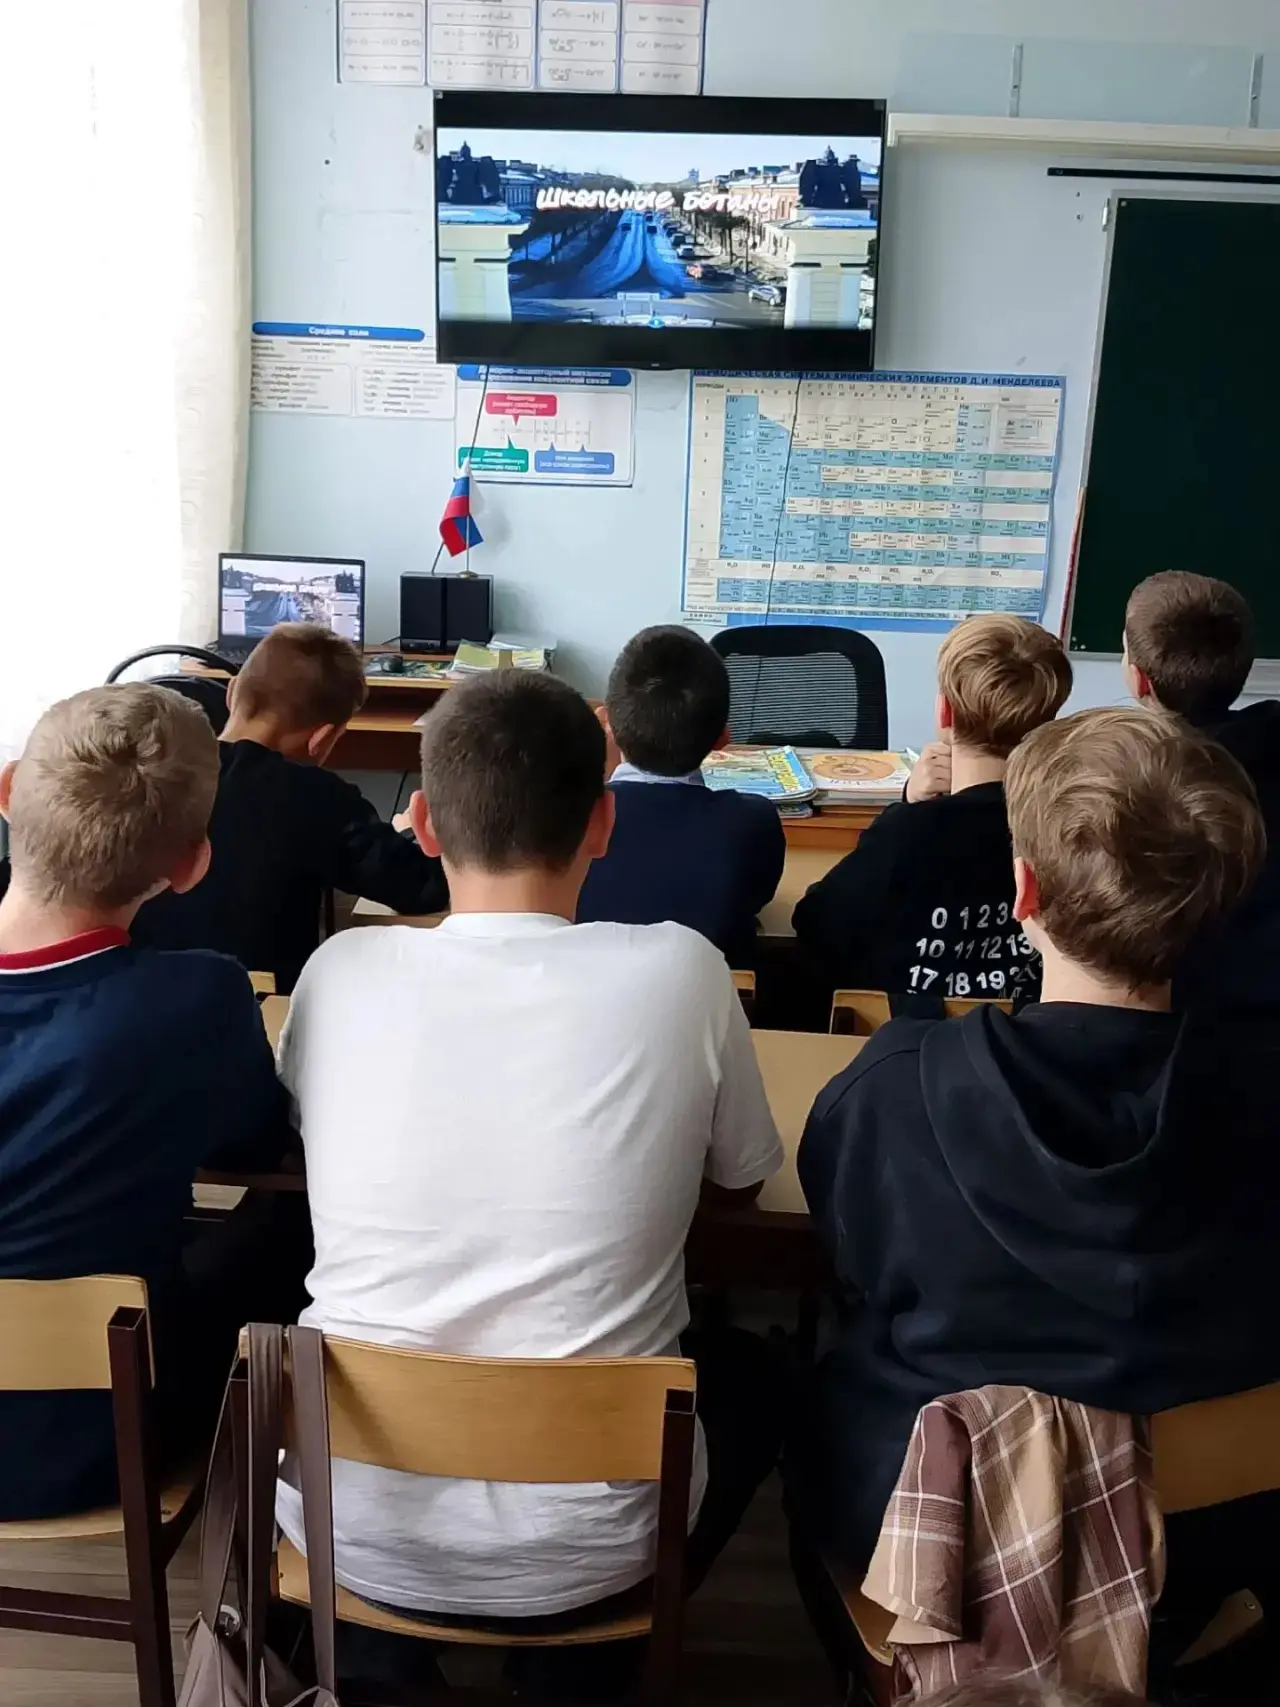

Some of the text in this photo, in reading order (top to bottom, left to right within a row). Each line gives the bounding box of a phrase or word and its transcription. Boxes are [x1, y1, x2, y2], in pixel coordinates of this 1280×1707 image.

[536, 186, 675, 212] Школьные
[905, 374, 967, 385] ЭЛЕМЕНТОВ
[992, 377, 1061, 387] МЕНДЕЛЕЕВА
[931, 902, 1009, 930] 0 1 2 3
[916, 933, 1034, 960] 10 11 12 13
[909, 965, 940, 991] 17
[945, 972, 971, 996] 18
[976, 970, 1006, 990] 19
